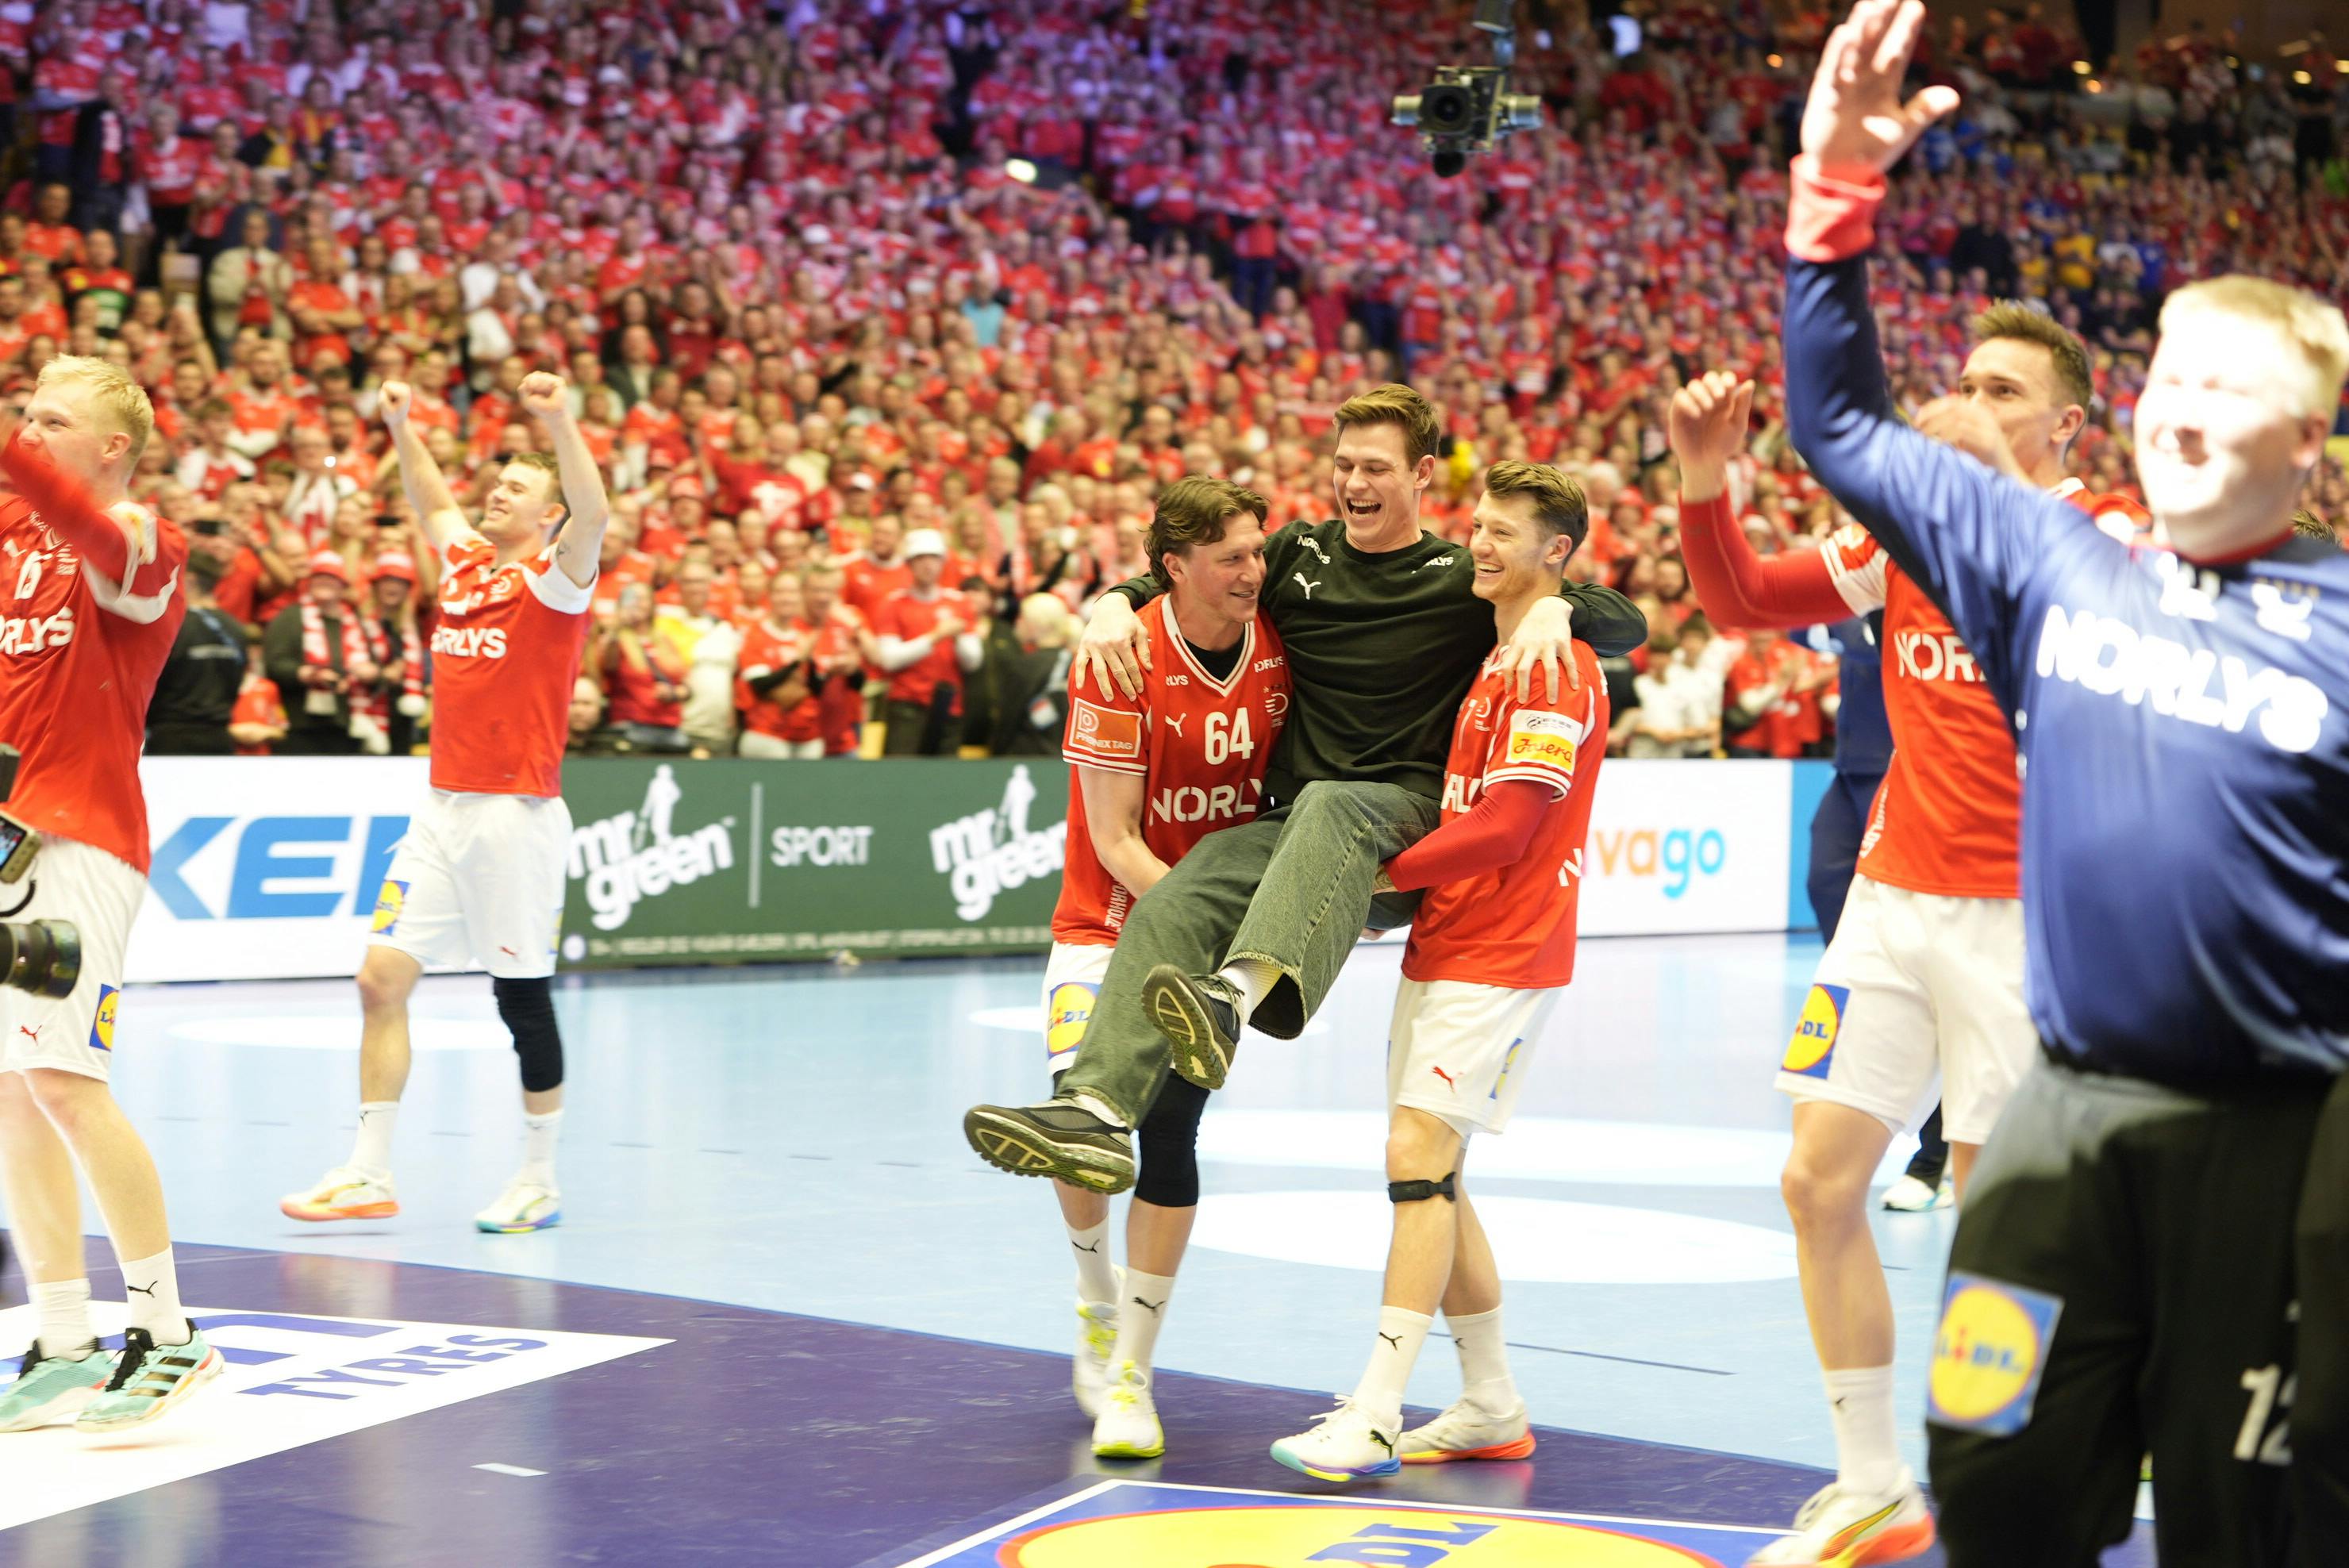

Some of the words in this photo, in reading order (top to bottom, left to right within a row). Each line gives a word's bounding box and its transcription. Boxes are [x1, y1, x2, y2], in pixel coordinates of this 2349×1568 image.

[1297, 535, 1331, 565] NORLYS
[1893, 632, 1987, 682] NOR
[2036, 604, 2328, 753] NORLYS
[1205, 706, 1255, 766] 64
[569, 810, 636, 878] mr
[771, 825, 874, 867] SPORT
[928, 808, 996, 874] mr
[586, 824, 734, 931] green
[235, 1334, 548, 1401] TYRES
